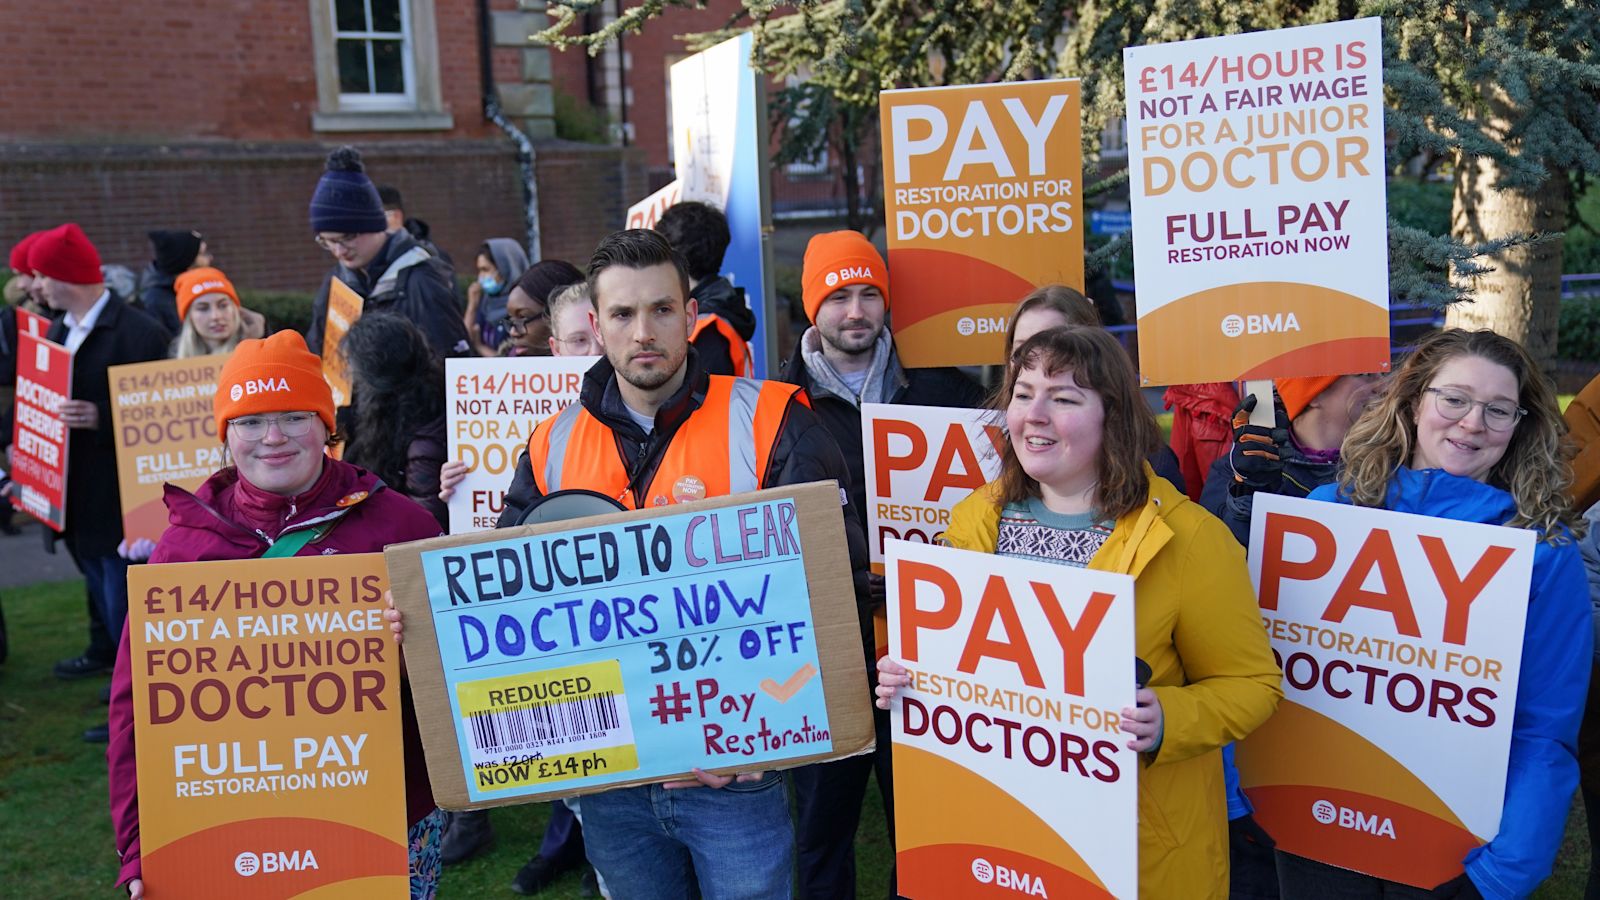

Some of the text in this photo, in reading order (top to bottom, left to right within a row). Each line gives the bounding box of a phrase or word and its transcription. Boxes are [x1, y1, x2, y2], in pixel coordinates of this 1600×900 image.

[1139, 41, 1367, 93] £14/HOUR IS
[1140, 75, 1368, 120] NOT A FAIR WAGE
[891, 94, 1070, 184] PAY
[1141, 103, 1369, 152] FOR A JUNIOR
[1142, 135, 1371, 197] DOCTOR
[895, 179, 1072, 205] RESTORATION FOR
[895, 201, 1073, 241] DOCTORS
[1166, 209, 1267, 245] FULL
[1278, 200, 1351, 236] PAY
[1168, 234, 1351, 264] RESTORATION NOW
[840, 266, 872, 280] BMA
[1247, 312, 1300, 334] BMA
[118, 366, 215, 391] £14/HOUR
[245, 377, 290, 395] BMA
[456, 372, 580, 395] £14/HOUR
[118, 391, 148, 406] NOT
[151, 390, 161, 402] A
[163, 385, 195, 400] FAIR
[456, 399, 579, 415] NOT A FAIR W
[120, 406, 155, 422] FOR
[161, 404, 172, 418] A
[456, 420, 502, 439] FOR
[506, 420, 521, 439] A
[18, 428, 59, 467] BETTER
[122, 415, 217, 448] DOCTO
[135, 451, 192, 473] FULL
[685, 477, 698, 486] PAY
[473, 517, 498, 528] RES
[877, 503, 950, 525] RESTOR
[442, 502, 801, 606] REDUCED TO CLEAR
[144, 575, 382, 614] £14/HOUR IS
[1259, 512, 1516, 646] PAY
[145, 609, 384, 643] NOT A FAIR WAGE
[458, 573, 771, 663] DOCTORS NOW
[897, 558, 1116, 697] PAY
[147, 637, 385, 676] FOR A JUNIOR
[648, 621, 806, 674] 30% OFF
[1445, 653, 1503, 682] FOR
[148, 669, 387, 725] DOCTOR
[488, 676, 592, 706] REDUCED
[1272, 646, 1498, 728] OCTORS
[702, 714, 830, 756] Restoration
[1069, 704, 1120, 734] FOR
[174, 733, 368, 777] FULL PAY
[902, 695, 1120, 783] DOCTORS
[474, 759, 499, 770] was
[479, 765, 530, 786] NOW
[176, 769, 369, 797] RESTORATION NOW
[1338, 806, 1396, 840] BMA
[262, 849, 319, 873] BMA
[996, 865, 1048, 899] BMA
